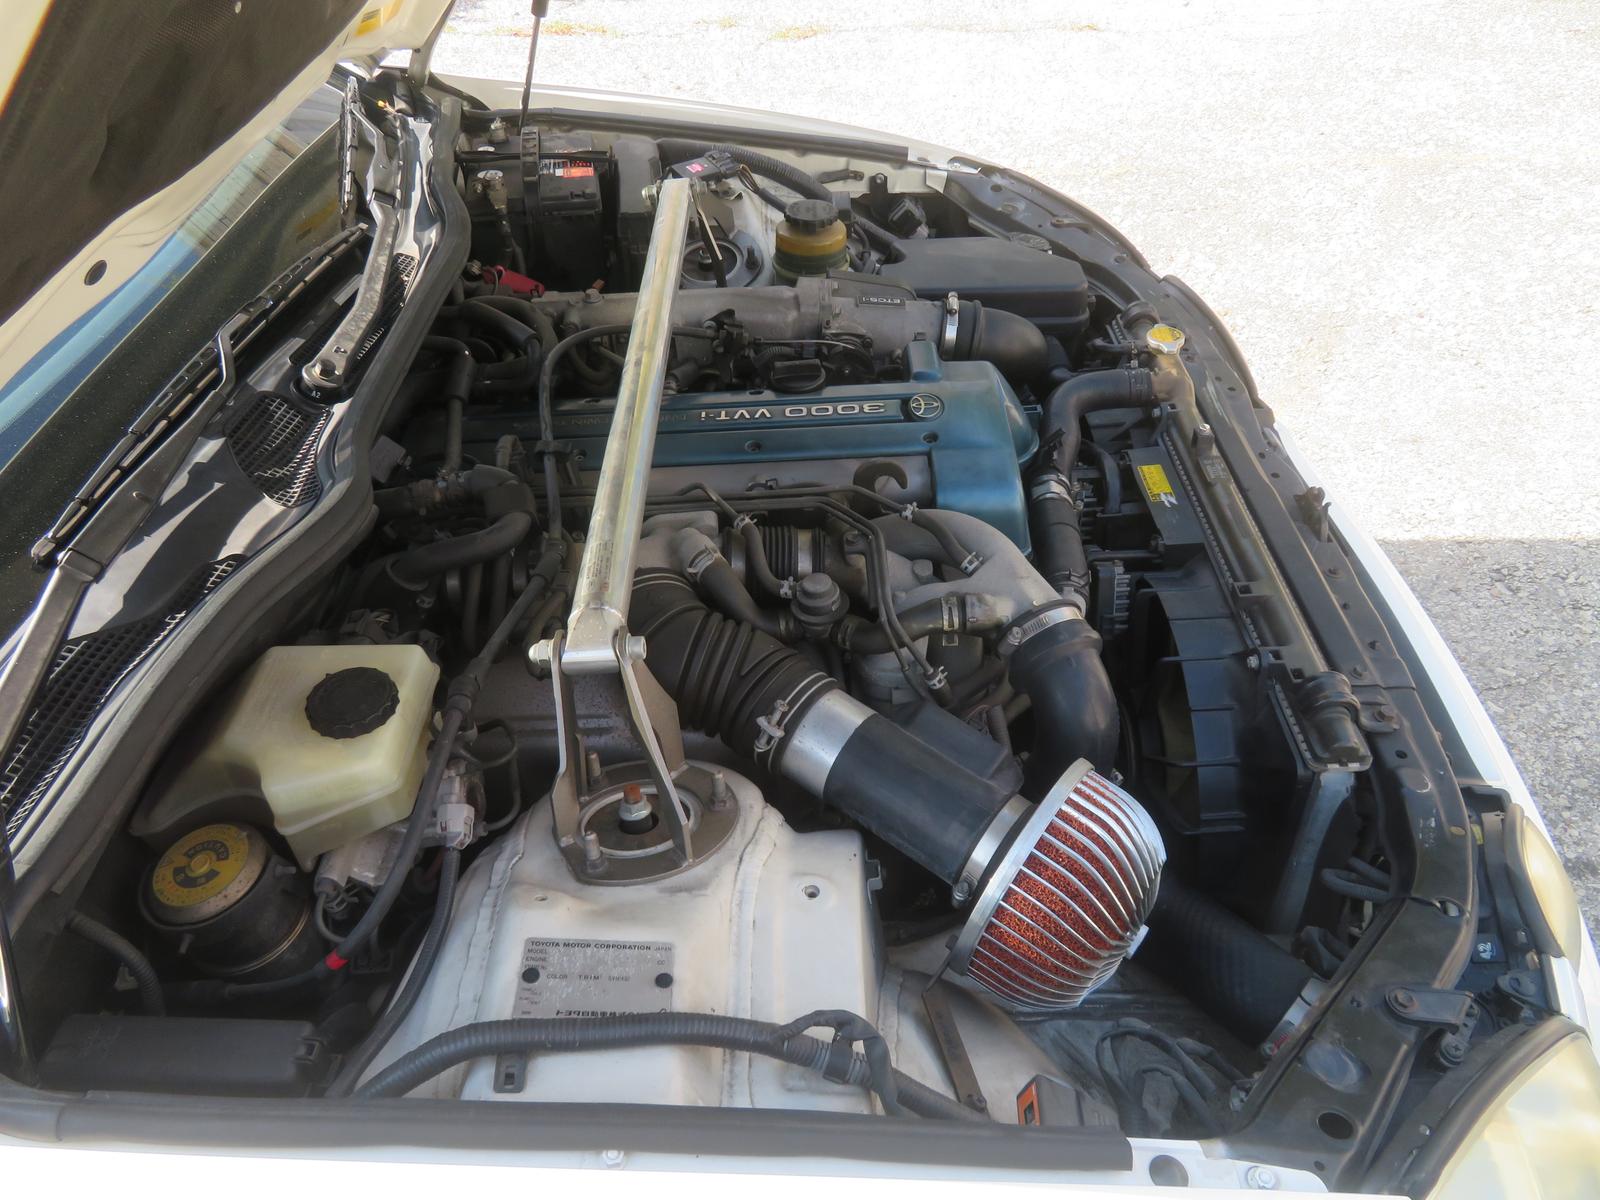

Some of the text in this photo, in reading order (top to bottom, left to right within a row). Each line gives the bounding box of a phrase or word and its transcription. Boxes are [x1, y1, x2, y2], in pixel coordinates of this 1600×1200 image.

[700, 408, 772, 420] VVT-i
[784, 402, 885, 417] 3000
[530, 940, 561, 949] TOYOTA
[562, 942, 592, 950] MOTOR
[594, 943, 651, 951] CORPORATION
[578, 974, 600, 982] TRIM
